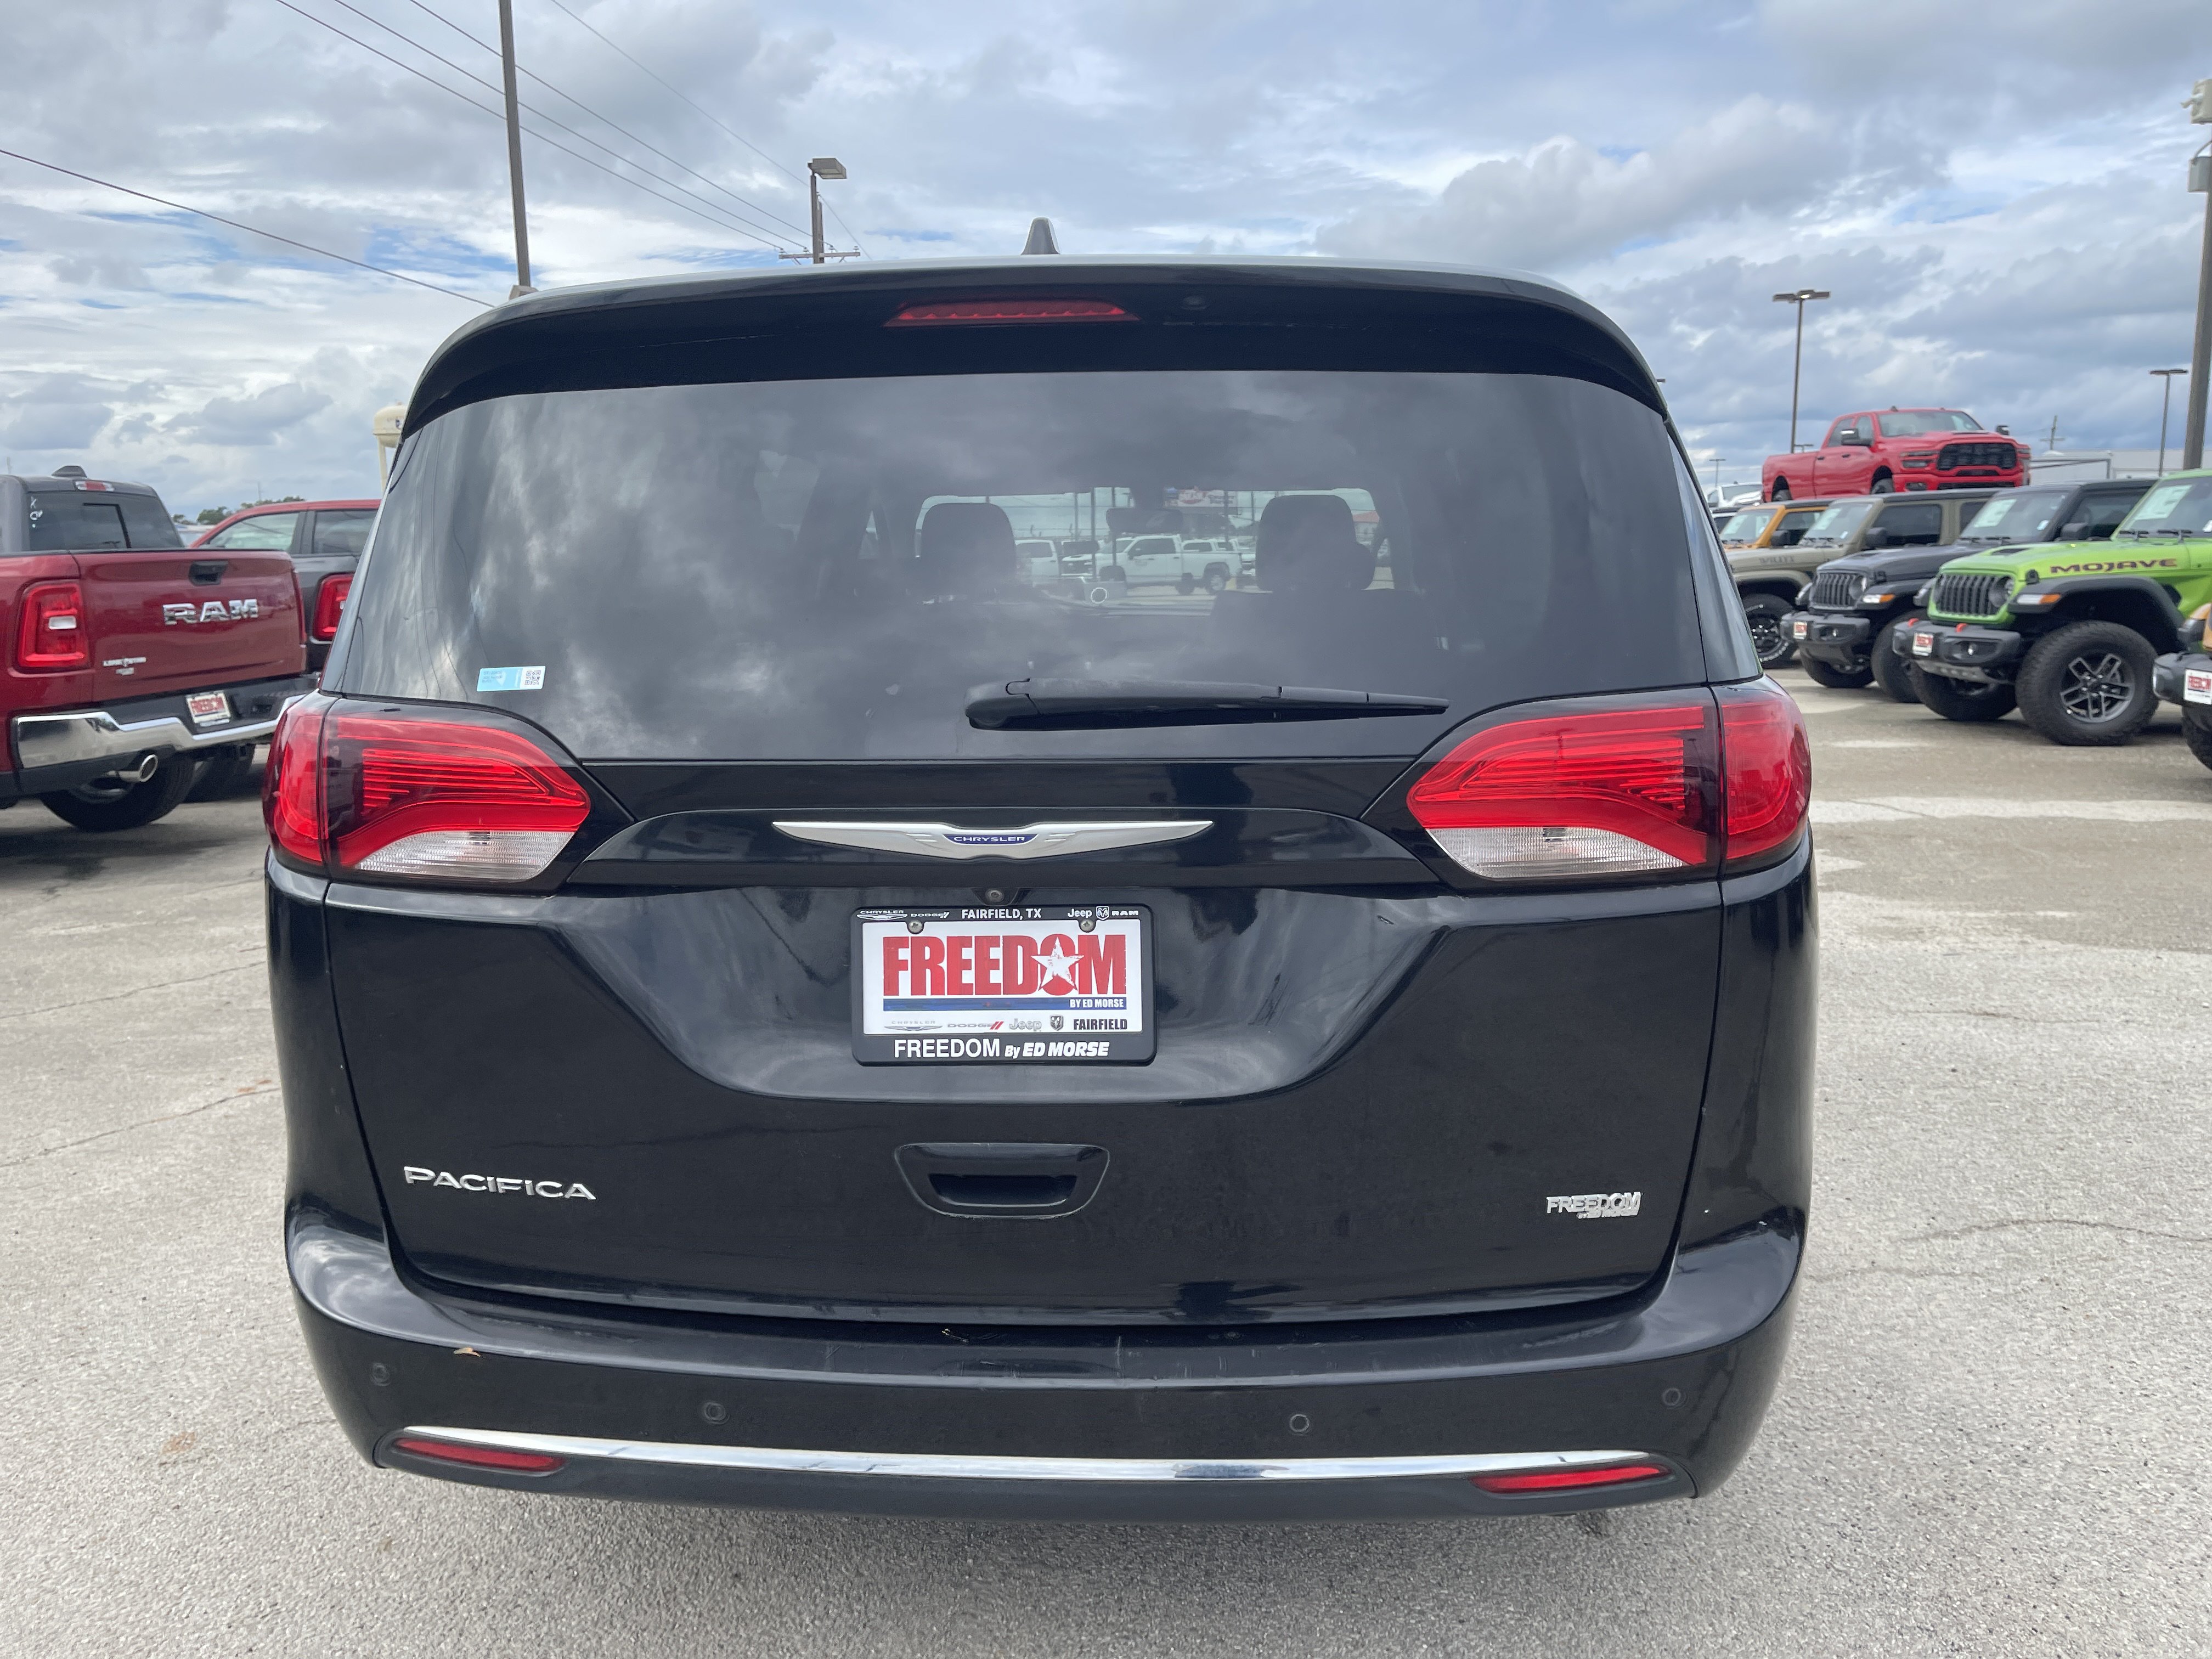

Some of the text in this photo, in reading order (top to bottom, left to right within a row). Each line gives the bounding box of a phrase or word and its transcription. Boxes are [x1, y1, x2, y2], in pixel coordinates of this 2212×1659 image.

[2050, 558, 2177, 573] MOJAVE
[162, 599, 258, 625] RAM
[961, 909, 1042, 920] FAIRFIELD, TX
[1067, 908, 1092, 918] Jeep
[883, 934, 1127, 996] FREEDOM
[1070, 998, 1124, 1008] BY ED MORSE
[1009, 1018, 1042, 1031] Jeep
[1074, 1019, 1127, 1030] FAIRFIELD
[894, 1038, 1110, 1059] FREEDOM By ED MORSE
[403, 1166, 597, 1200] PACIFICA
[1546, 1192, 1641, 1214] FREEDOM
